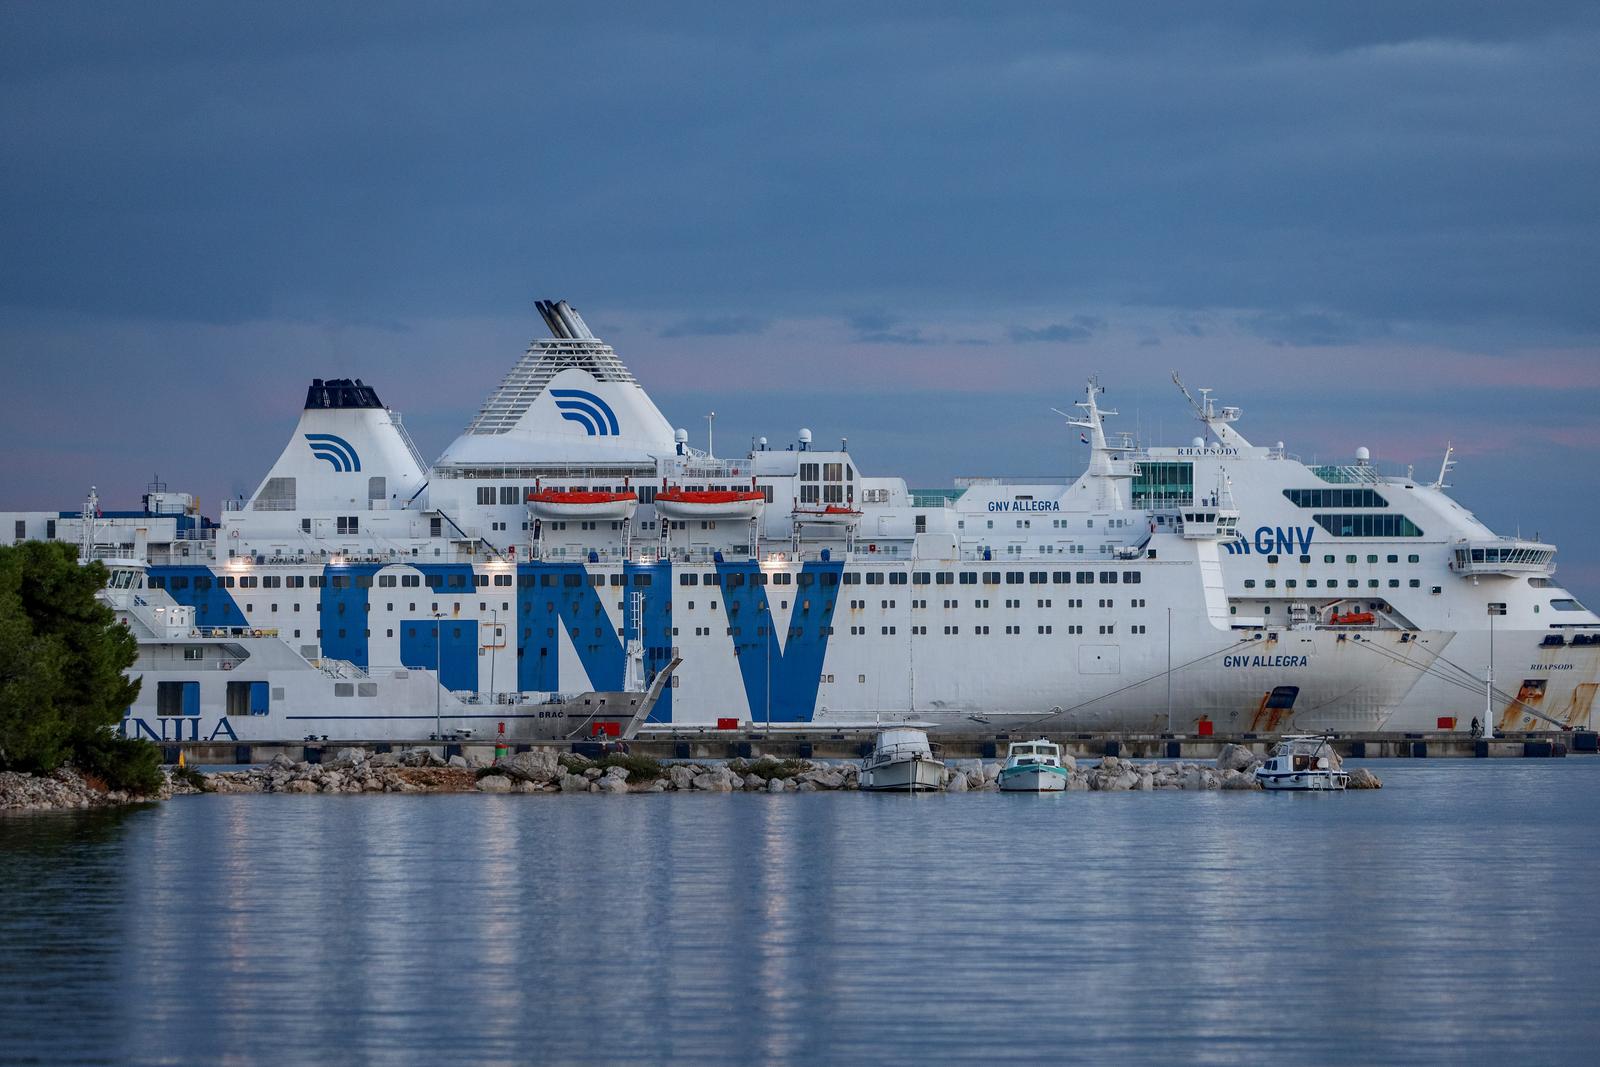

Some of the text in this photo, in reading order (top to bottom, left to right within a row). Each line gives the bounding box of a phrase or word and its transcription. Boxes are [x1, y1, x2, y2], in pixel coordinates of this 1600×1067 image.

[1177, 448, 1240, 456] RHAPSODY
[988, 501, 1060, 512] GNV ALLEGRA
[1254, 526, 1315, 555] GNV
[1223, 655, 1307, 667] GNV ALLEGRA
[1530, 663, 1574, 671] RHAPSODY
